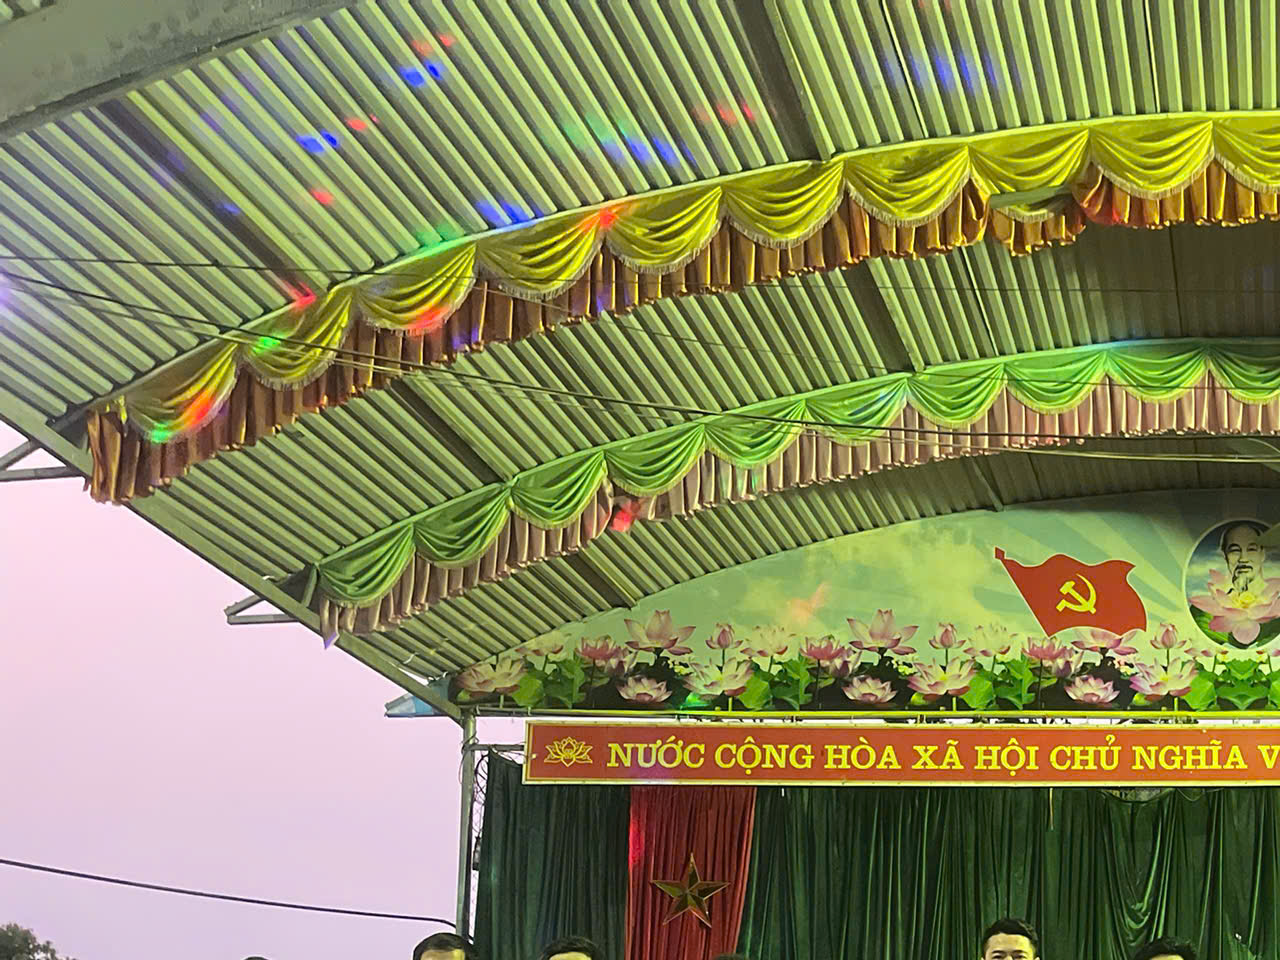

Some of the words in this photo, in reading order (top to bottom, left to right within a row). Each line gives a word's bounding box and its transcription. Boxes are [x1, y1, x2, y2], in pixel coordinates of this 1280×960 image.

[607, 736, 705, 770] NƯỚC
[714, 735, 815, 775] CỘNG
[824, 736, 902, 770] HÒA
[911, 737, 966, 770] XÃ
[974, 735, 1039, 776] HỘI
[1049, 734, 1121, 771] CHỦ
[1131, 736, 1248, 770] NGHĨA
